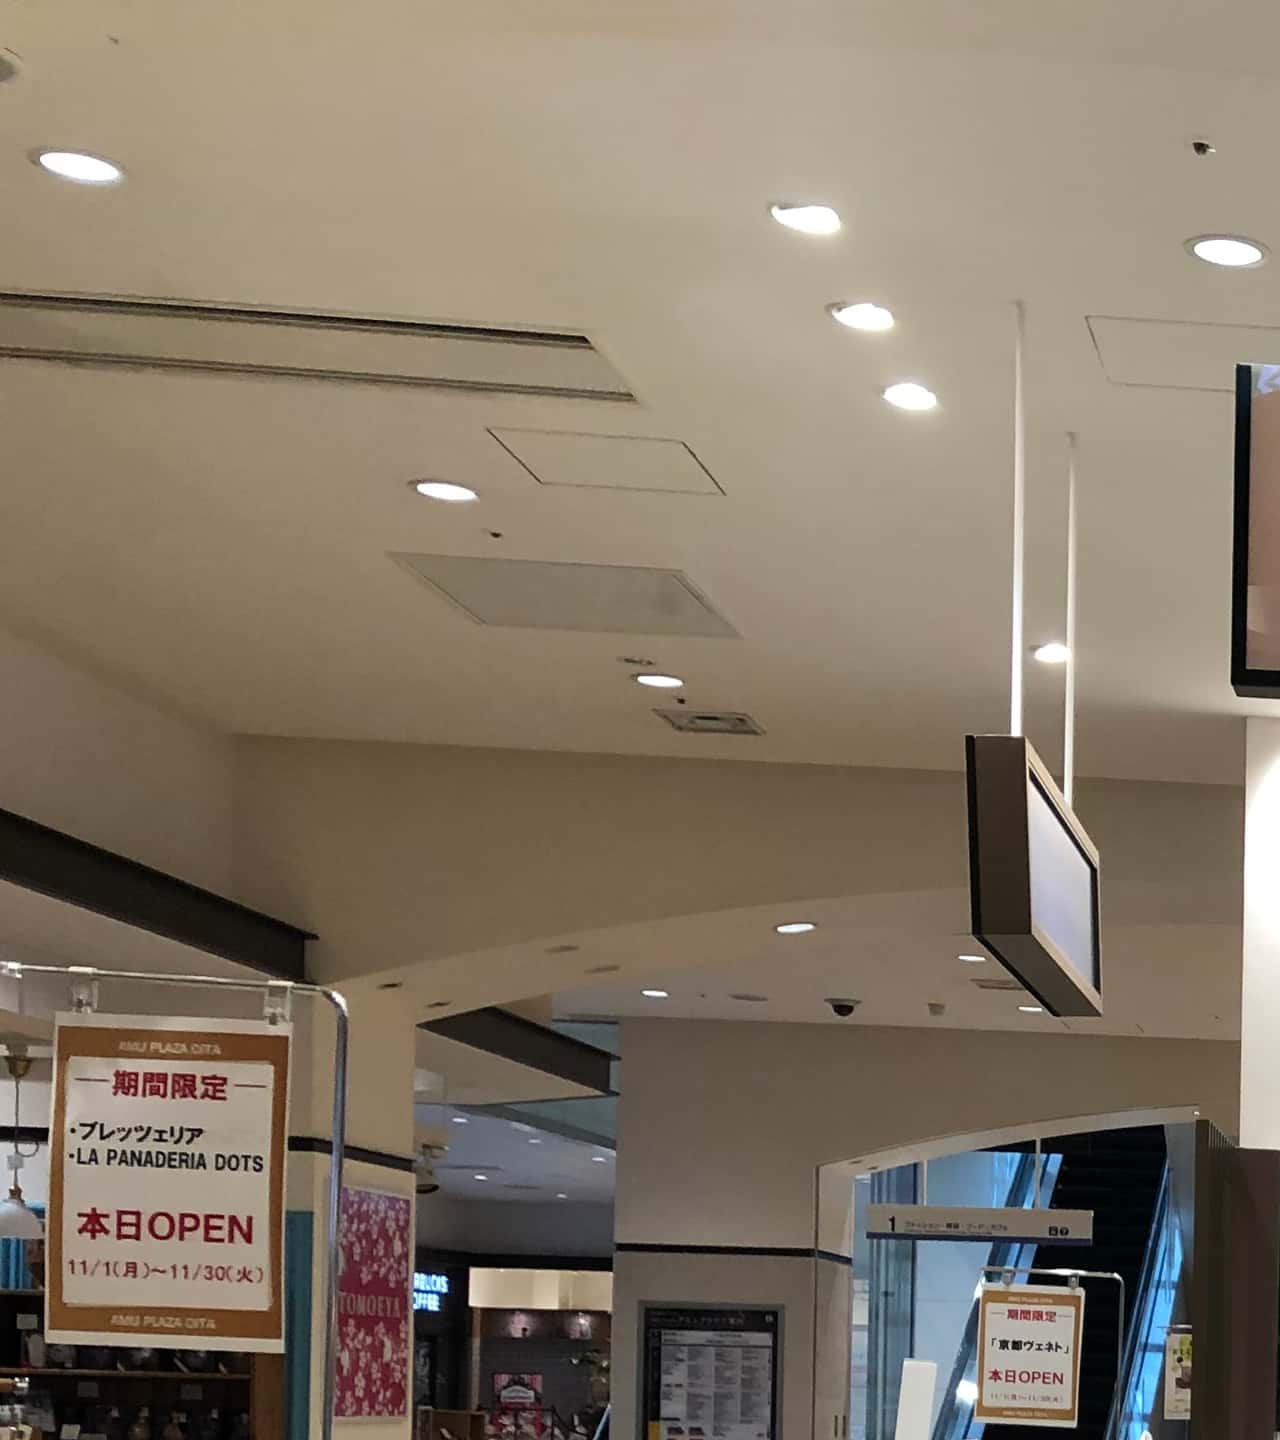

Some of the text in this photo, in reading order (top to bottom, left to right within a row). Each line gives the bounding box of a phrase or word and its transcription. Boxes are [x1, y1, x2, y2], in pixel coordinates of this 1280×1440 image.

[150, 1041, 187, 1055] PLAZA
[112, 1069, 228, 1101] 期間限定
[107, 1150, 264, 1173] PANADERIA DOTS
[77, 1207, 254, 1245] 本日OPEN
[144, 1315, 181, 1329] PLAZA
[988, 1368, 1064, 1385] 本日OPEN
